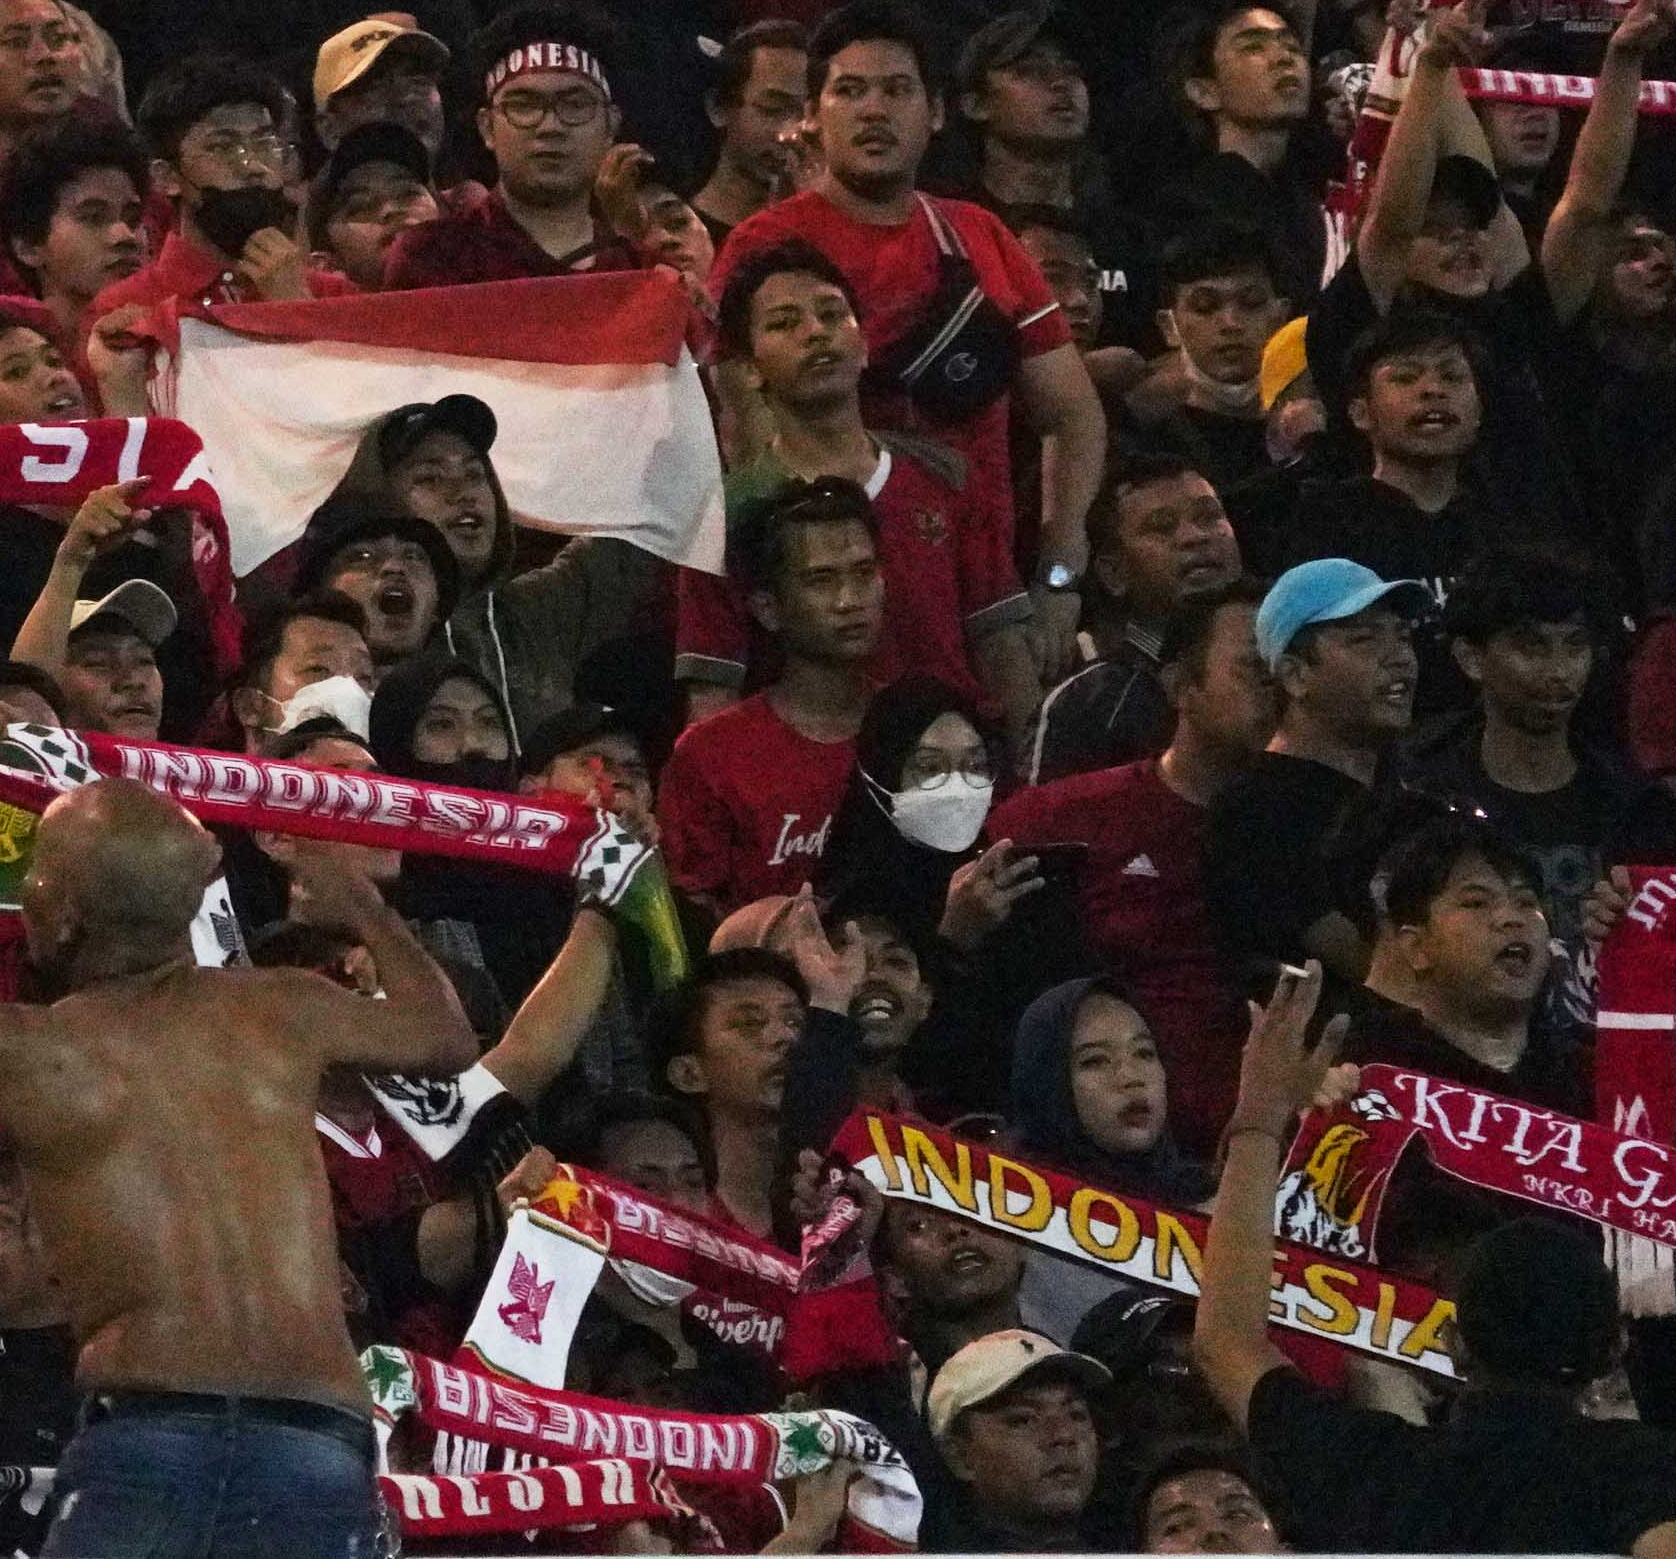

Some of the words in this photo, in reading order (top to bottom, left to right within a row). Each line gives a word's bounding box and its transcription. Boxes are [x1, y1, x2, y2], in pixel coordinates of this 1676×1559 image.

[115, 744, 566, 852] INDONESIA
[1395, 1074, 1587, 1173] KITA
[1612, 1138, 1676, 1207] G
